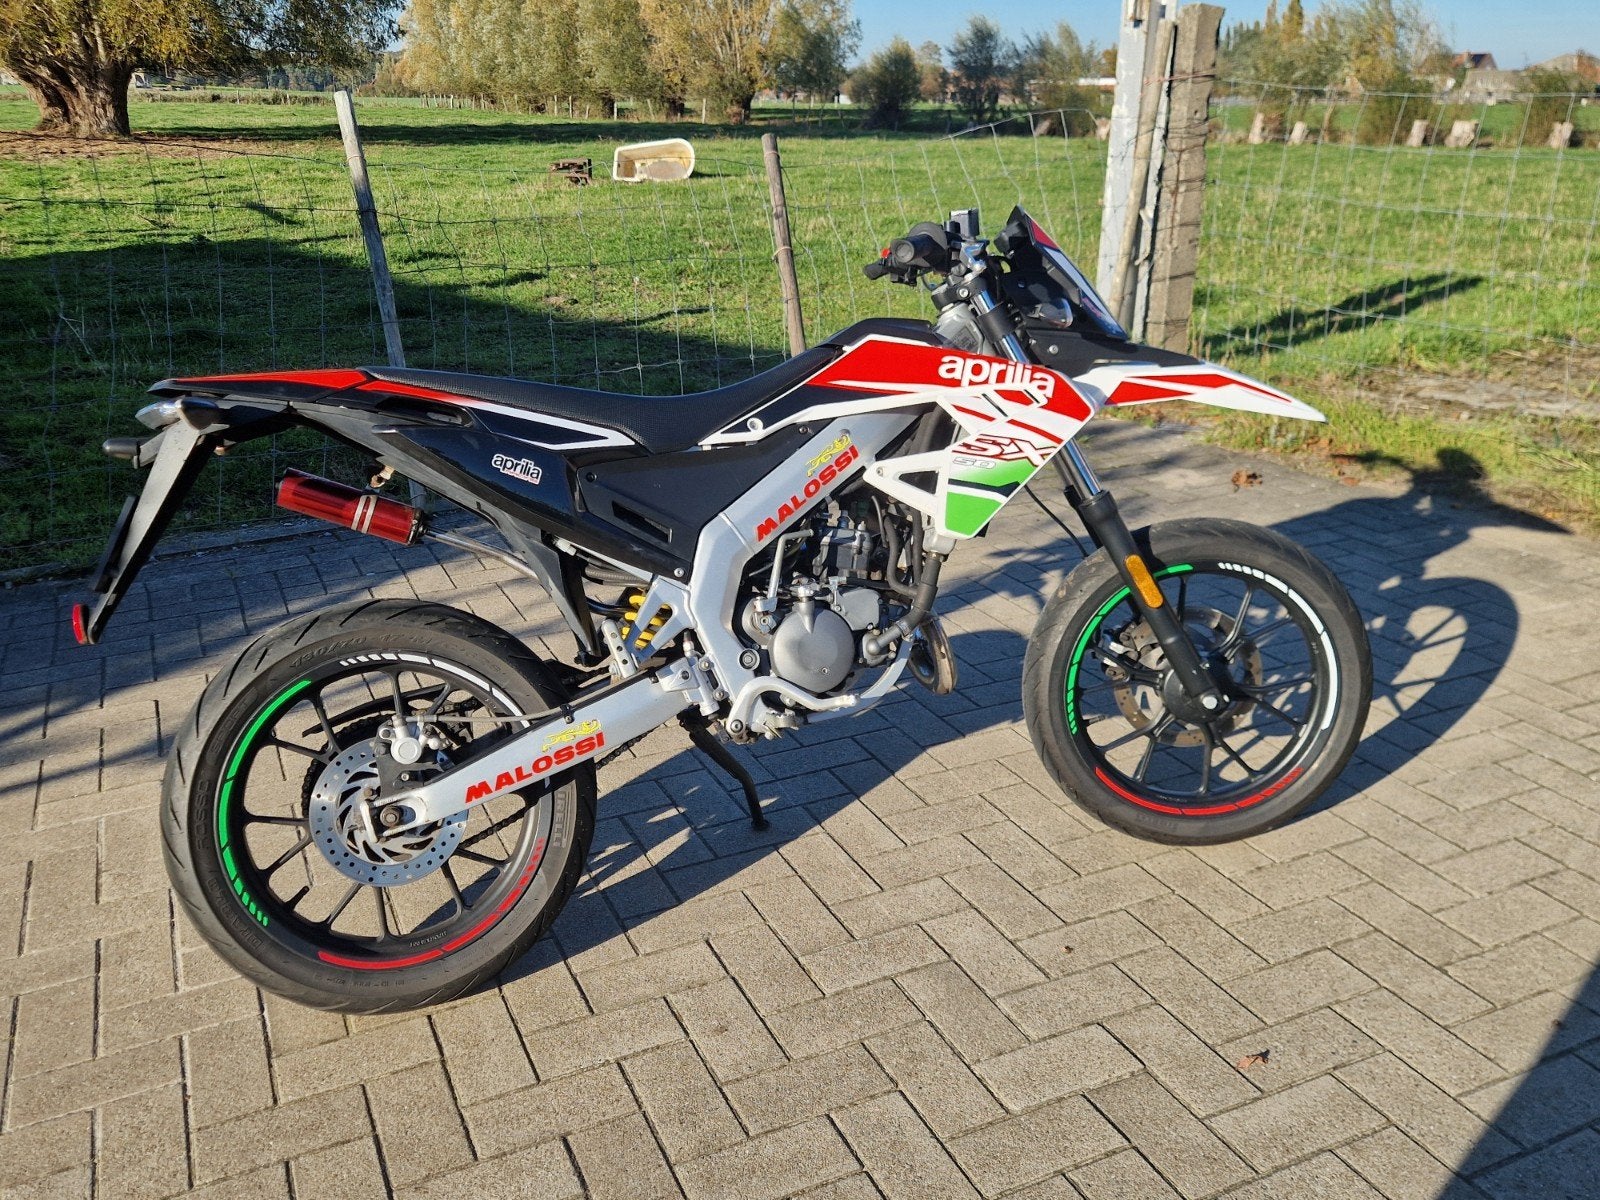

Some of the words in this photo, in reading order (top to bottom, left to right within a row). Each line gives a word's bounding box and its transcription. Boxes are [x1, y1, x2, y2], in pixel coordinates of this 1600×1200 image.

[938, 355, 1055, 398] aprilia
[493, 455, 541, 480] aprilia
[951, 433, 1058, 468] SX
[952, 456, 997, 470] 50
[756, 445, 860, 542] MALOSSI
[465, 732, 605, 804] MALOSSI
[552, 790, 567, 848] IRELLI
